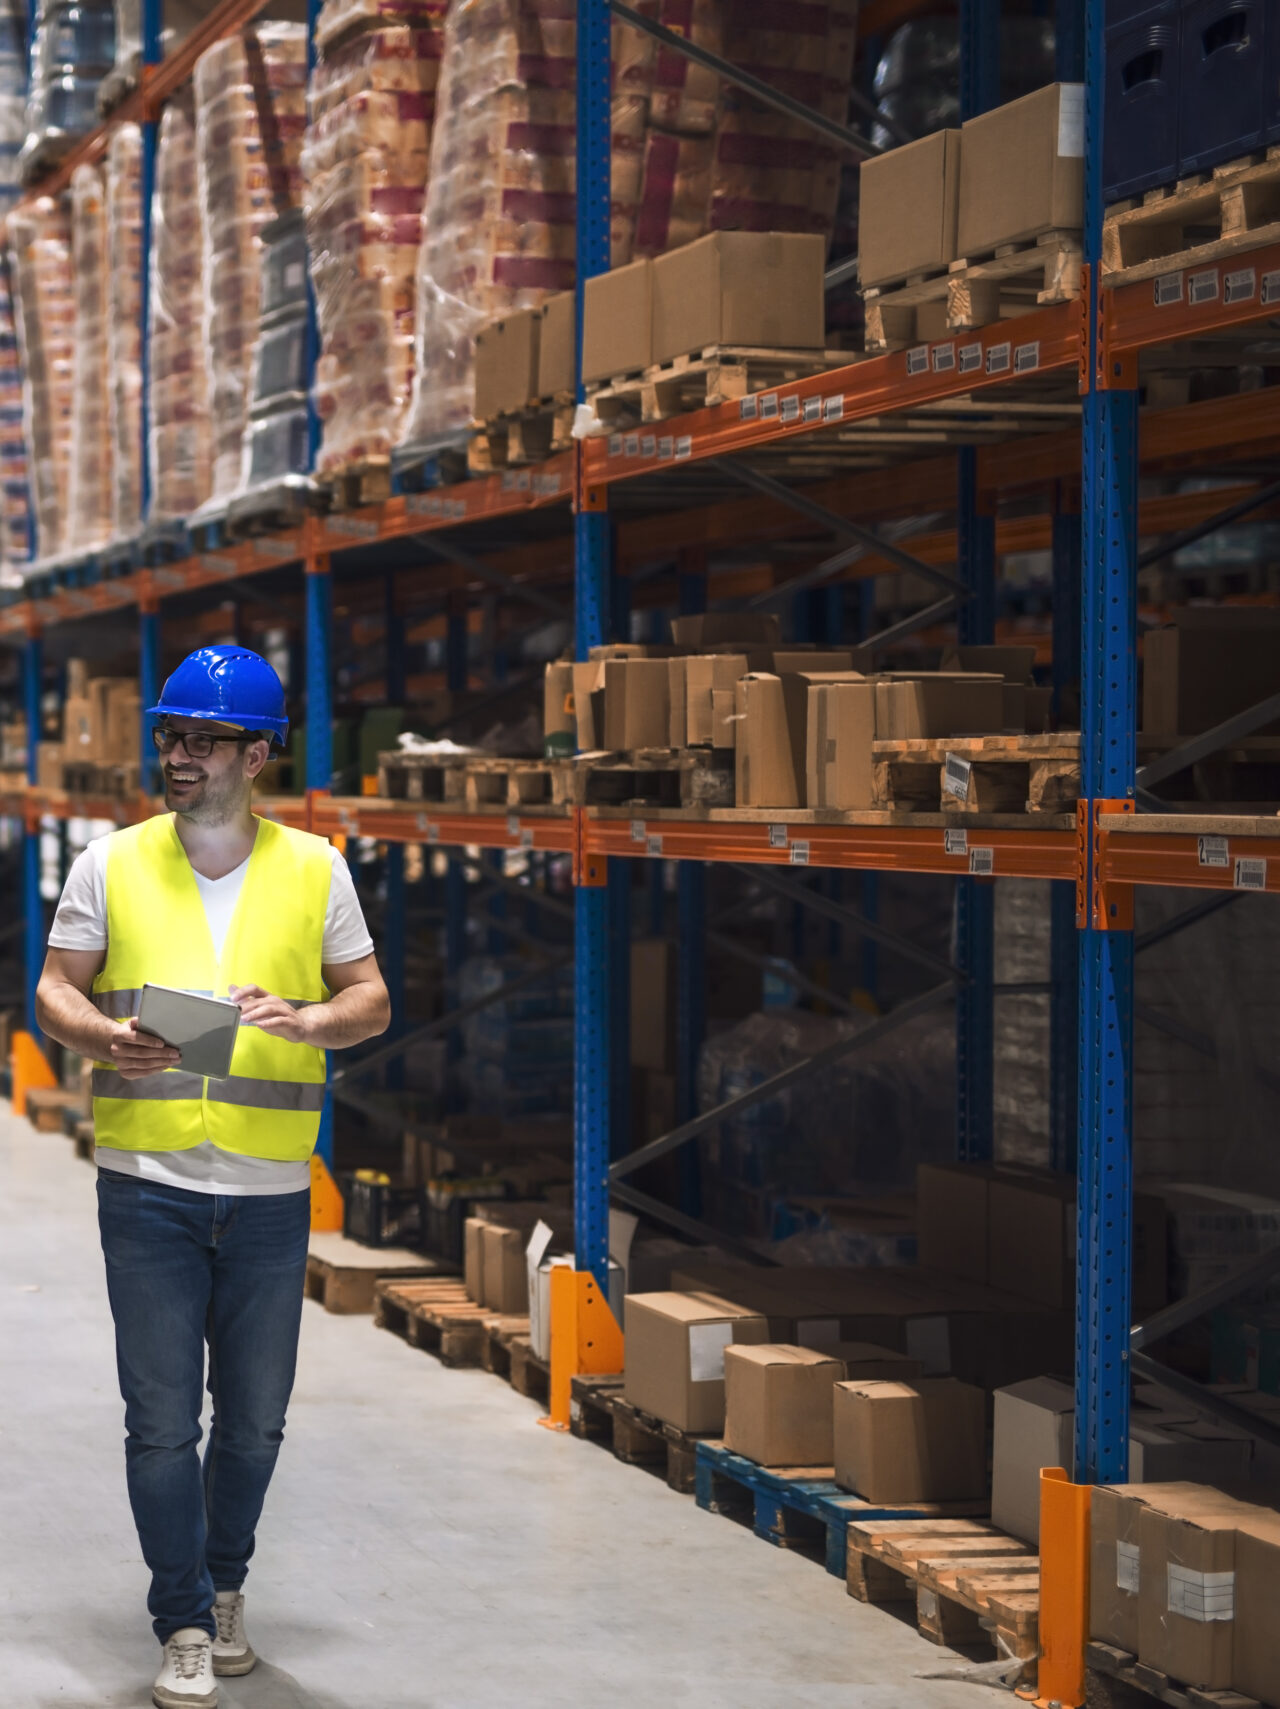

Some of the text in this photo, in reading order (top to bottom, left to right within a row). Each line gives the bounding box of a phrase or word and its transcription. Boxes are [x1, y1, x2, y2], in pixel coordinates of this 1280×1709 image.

[1154, 279, 1160, 305] 8
[1188, 277, 1194, 303] 7
[1224, 276, 1230, 303] 6
[1199, 837, 1205, 863] 2
